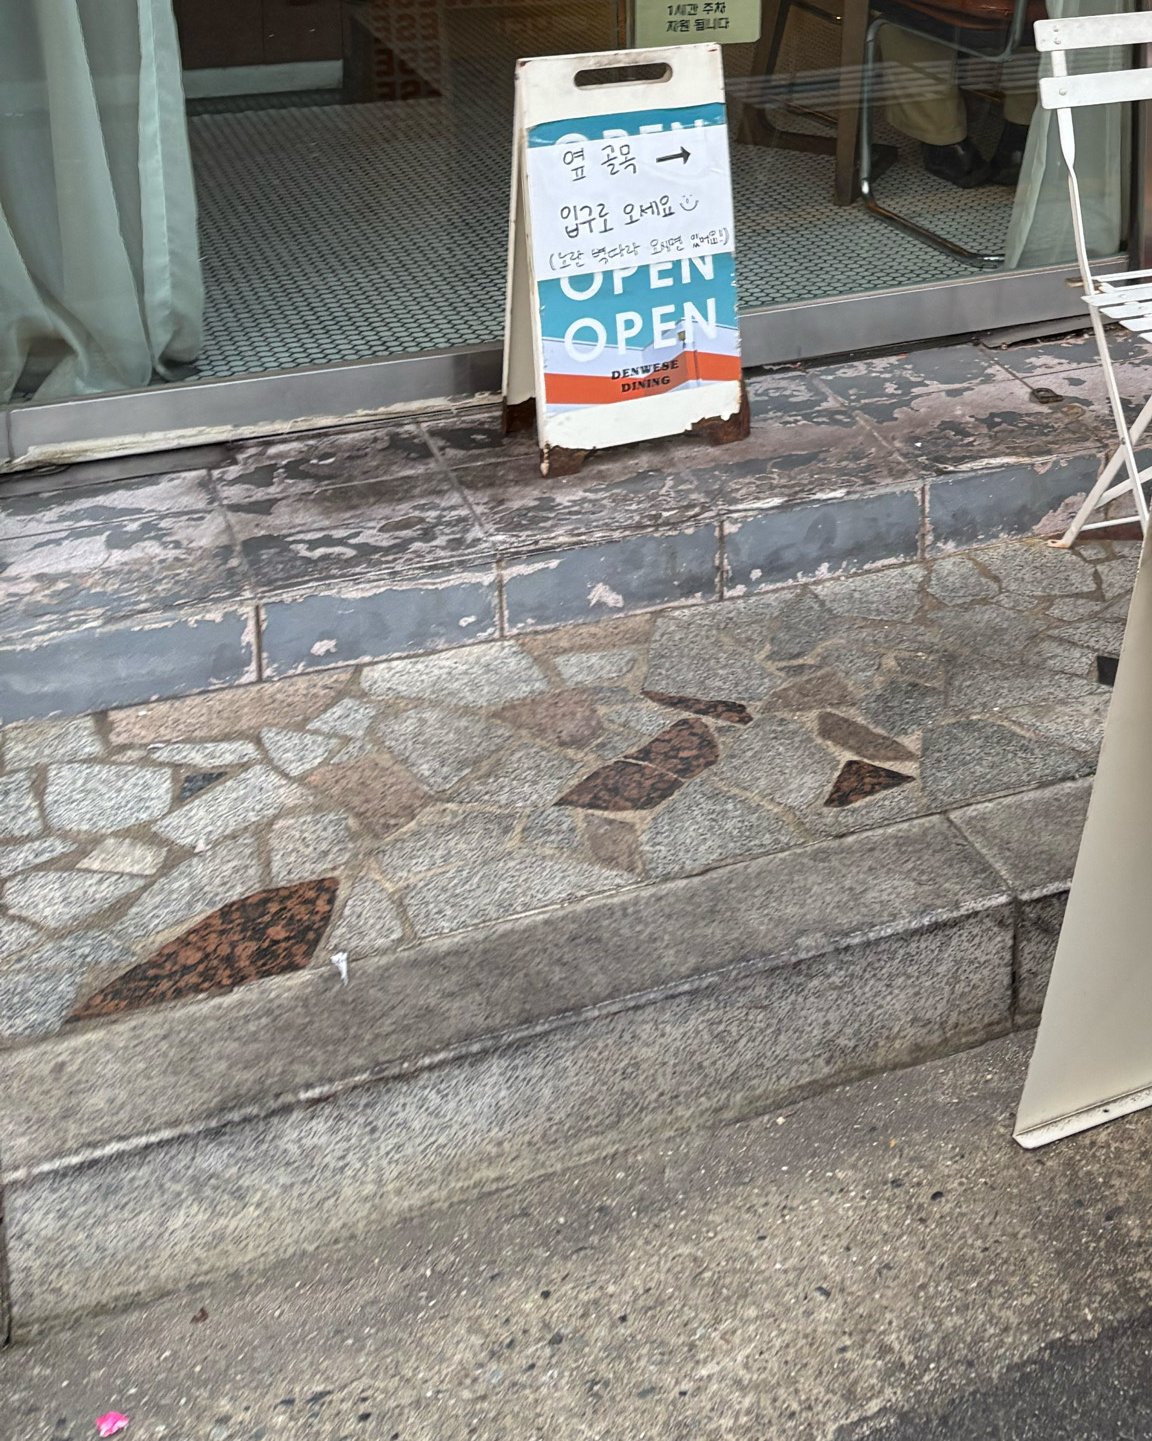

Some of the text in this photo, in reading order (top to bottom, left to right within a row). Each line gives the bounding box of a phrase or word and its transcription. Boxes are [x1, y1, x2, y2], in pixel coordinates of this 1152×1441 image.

[702, 1, 727, 15] 주차
[562, 144, 638, 182] 옆 골목
[560, 195, 676, 239] 입구로 오세요
[560, 256, 715, 301] OPEN
[564, 297, 717, 362] OPEN
[611, 359, 680, 380] DENWESE
[621, 375, 671, 392] DINING
